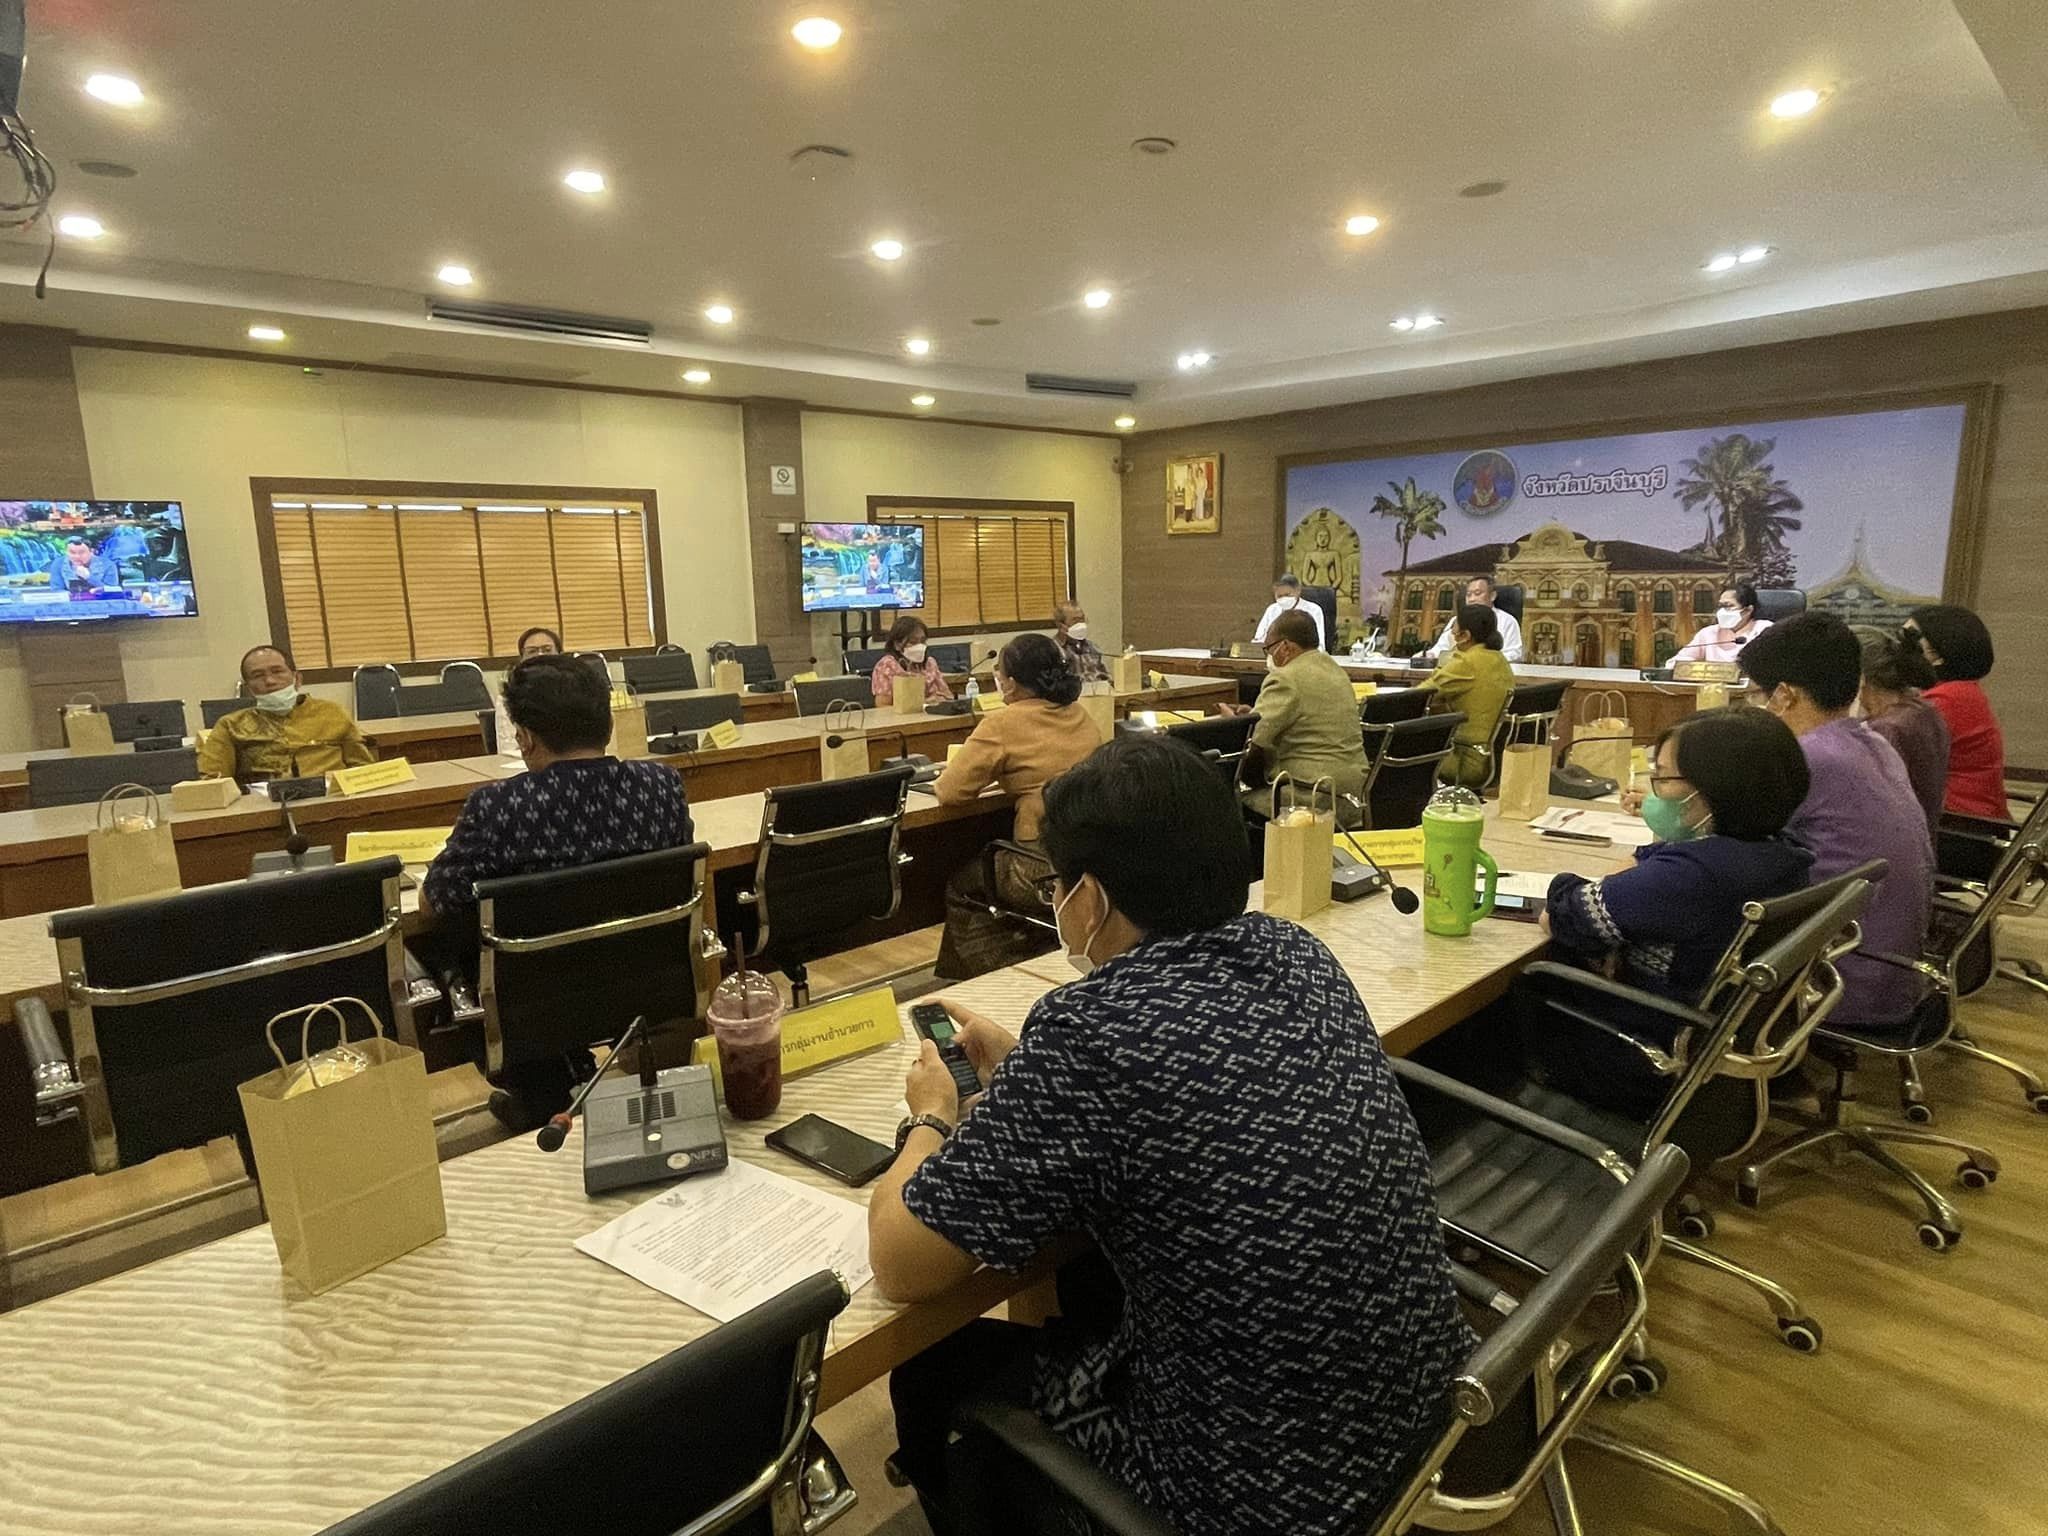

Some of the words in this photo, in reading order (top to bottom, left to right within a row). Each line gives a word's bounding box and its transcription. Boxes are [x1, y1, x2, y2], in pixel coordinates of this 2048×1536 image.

[1522, 465, 1668, 498] จังหวัดปราจีนบุรี
